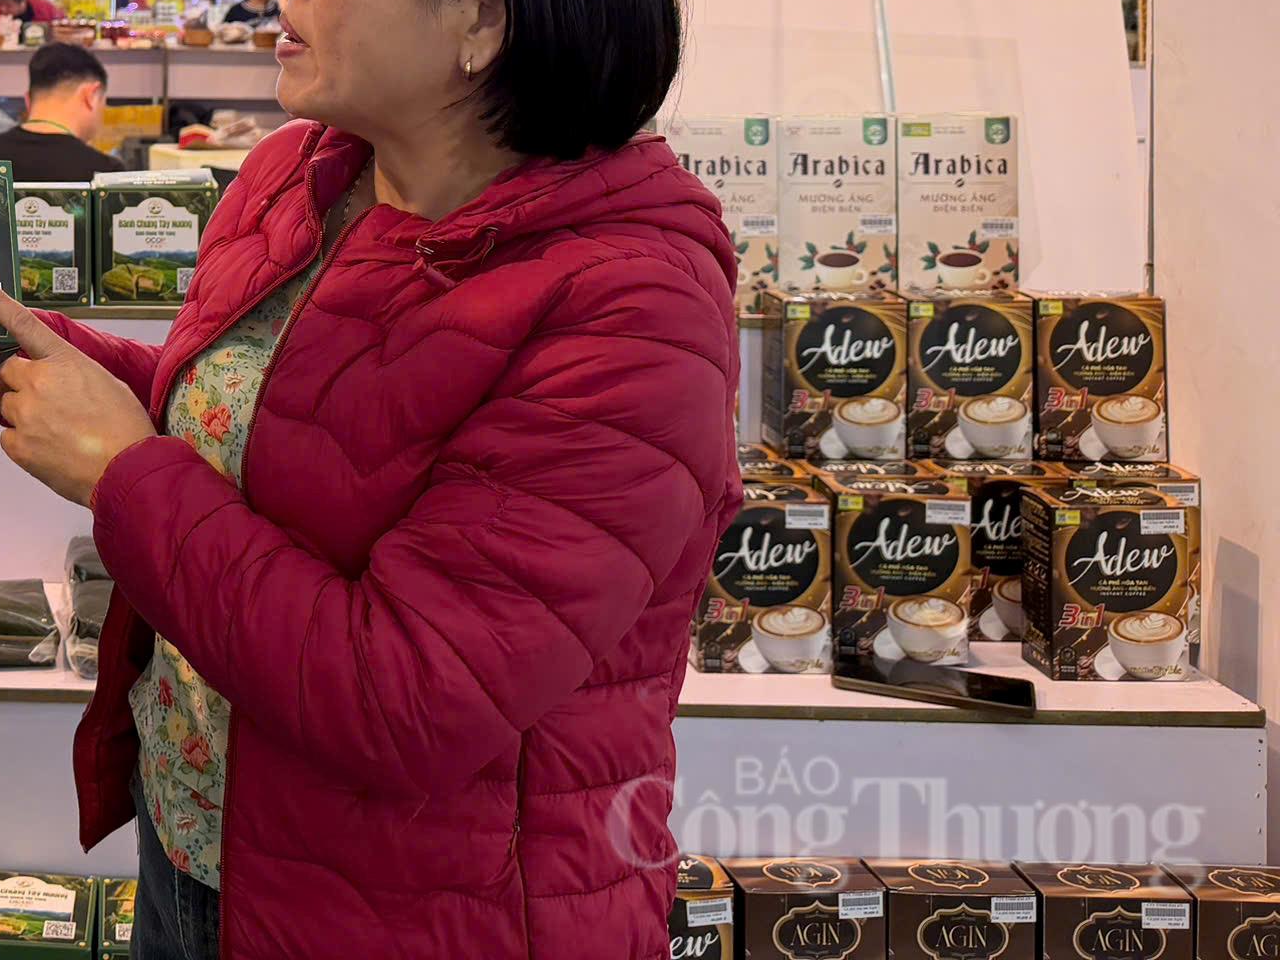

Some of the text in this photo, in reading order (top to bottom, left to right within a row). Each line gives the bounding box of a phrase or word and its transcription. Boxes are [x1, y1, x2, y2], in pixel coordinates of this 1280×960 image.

[788, 152, 886, 177] Arabica
[909, 152, 1008, 176] Arabica
[800, 323, 895, 375] Adew
[921, 321, 1020, 372] Adew
[1052, 319, 1152, 371] Adew
[970, 498, 1021, 541] Ade
[715, 526, 817, 580] Adew
[850, 517, 957, 568] Adew
[1068, 530, 1176, 586] Adew
[790, 922, 841, 947] AGIN
[936, 925, 987, 949] AGIN
[1092, 927, 1145, 952] AGIN
[1246, 936, 1280, 957] AG
